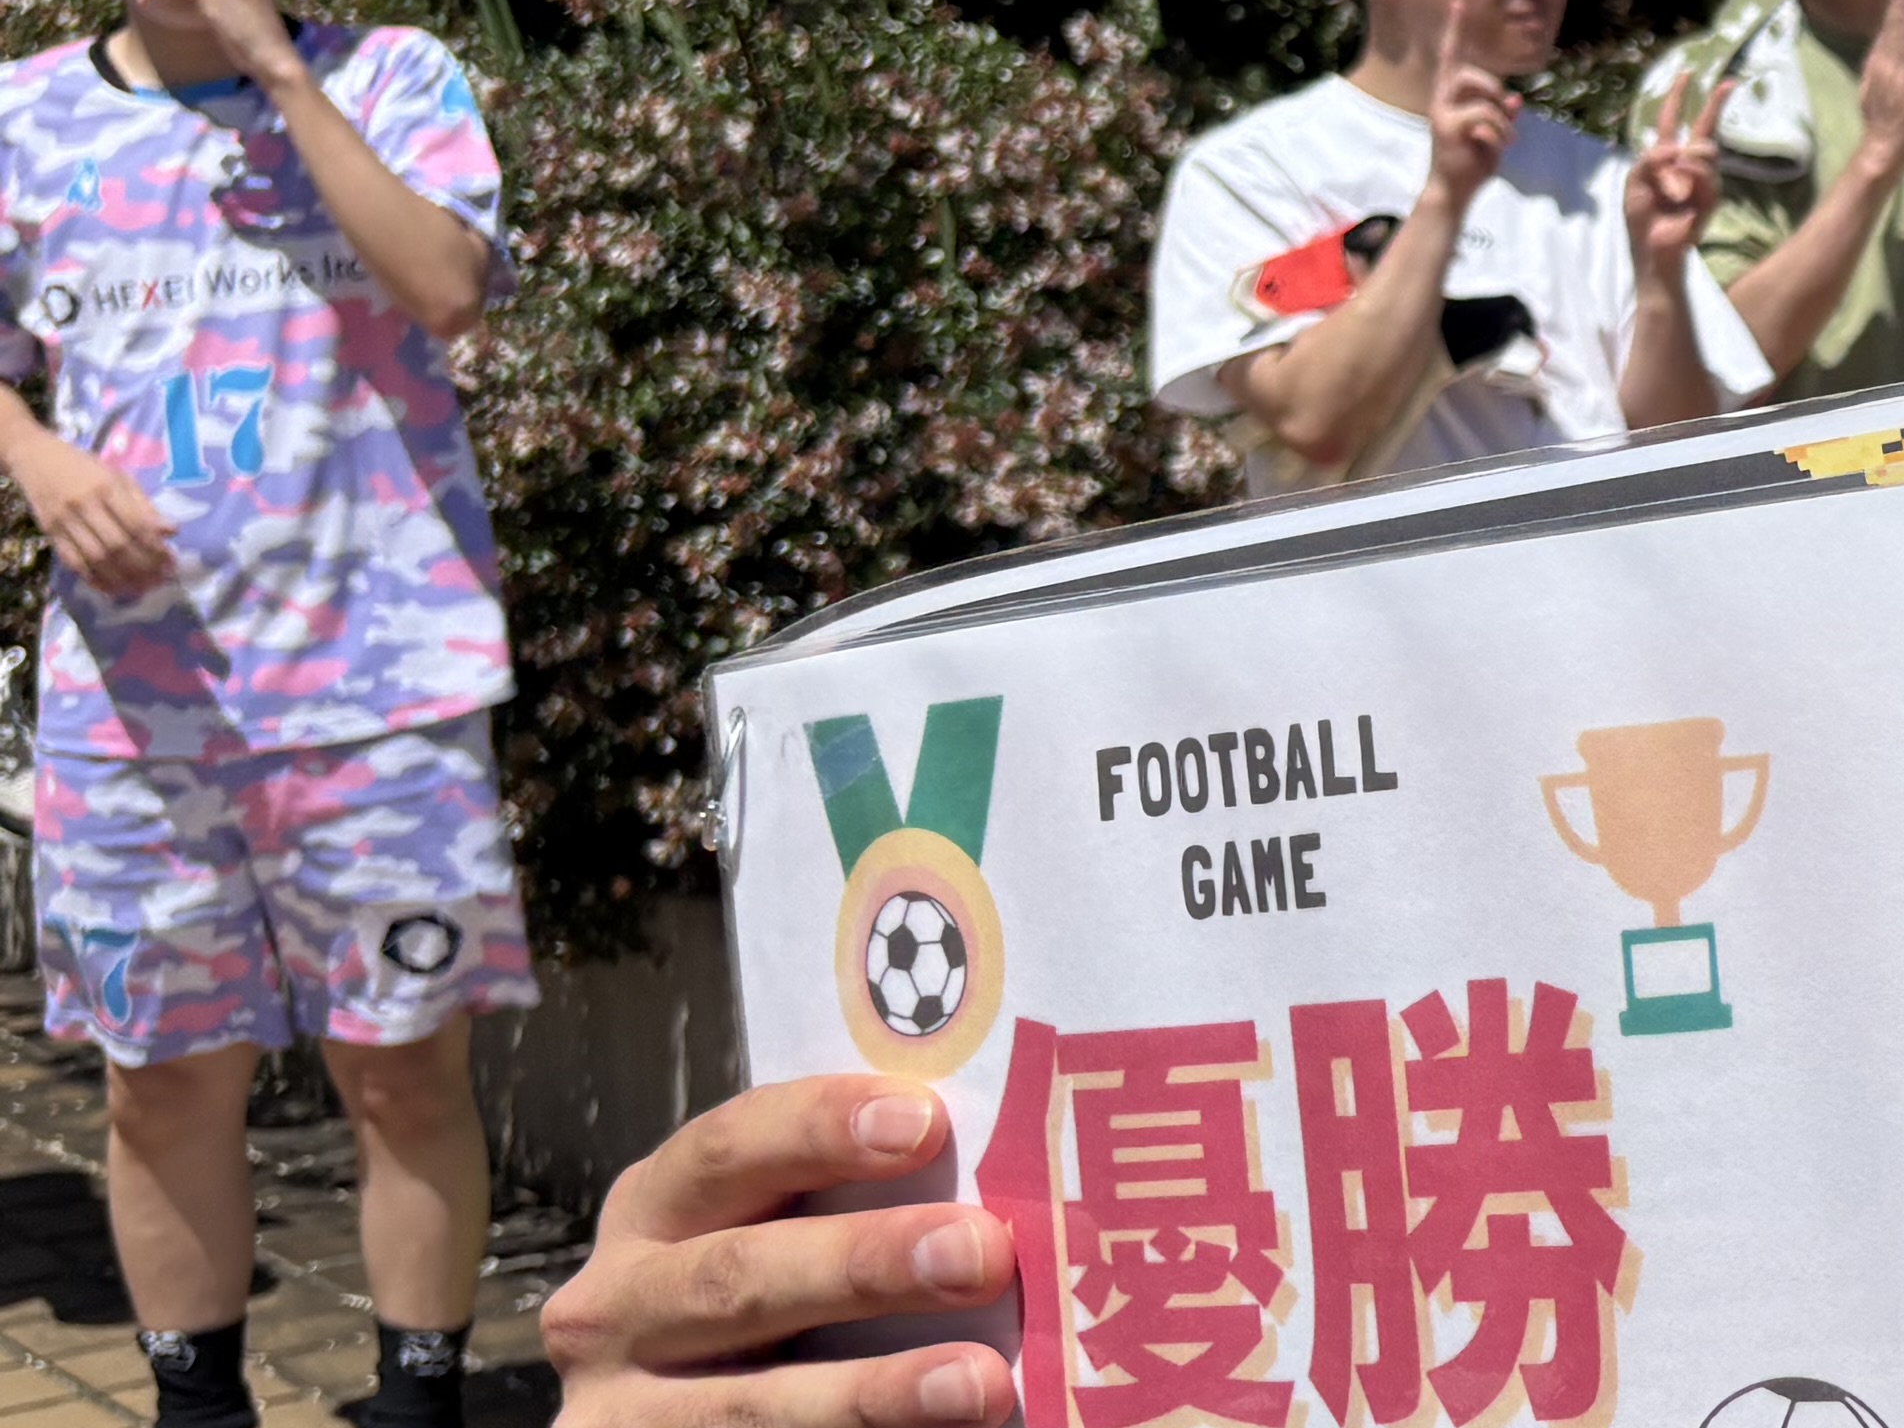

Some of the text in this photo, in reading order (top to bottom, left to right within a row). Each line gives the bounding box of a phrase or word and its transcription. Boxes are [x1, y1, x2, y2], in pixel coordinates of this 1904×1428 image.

[162, 362, 273, 485] 17
[1096, 715, 1398, 821] FOOTBALL
[1181, 833, 1326, 920] GAME
